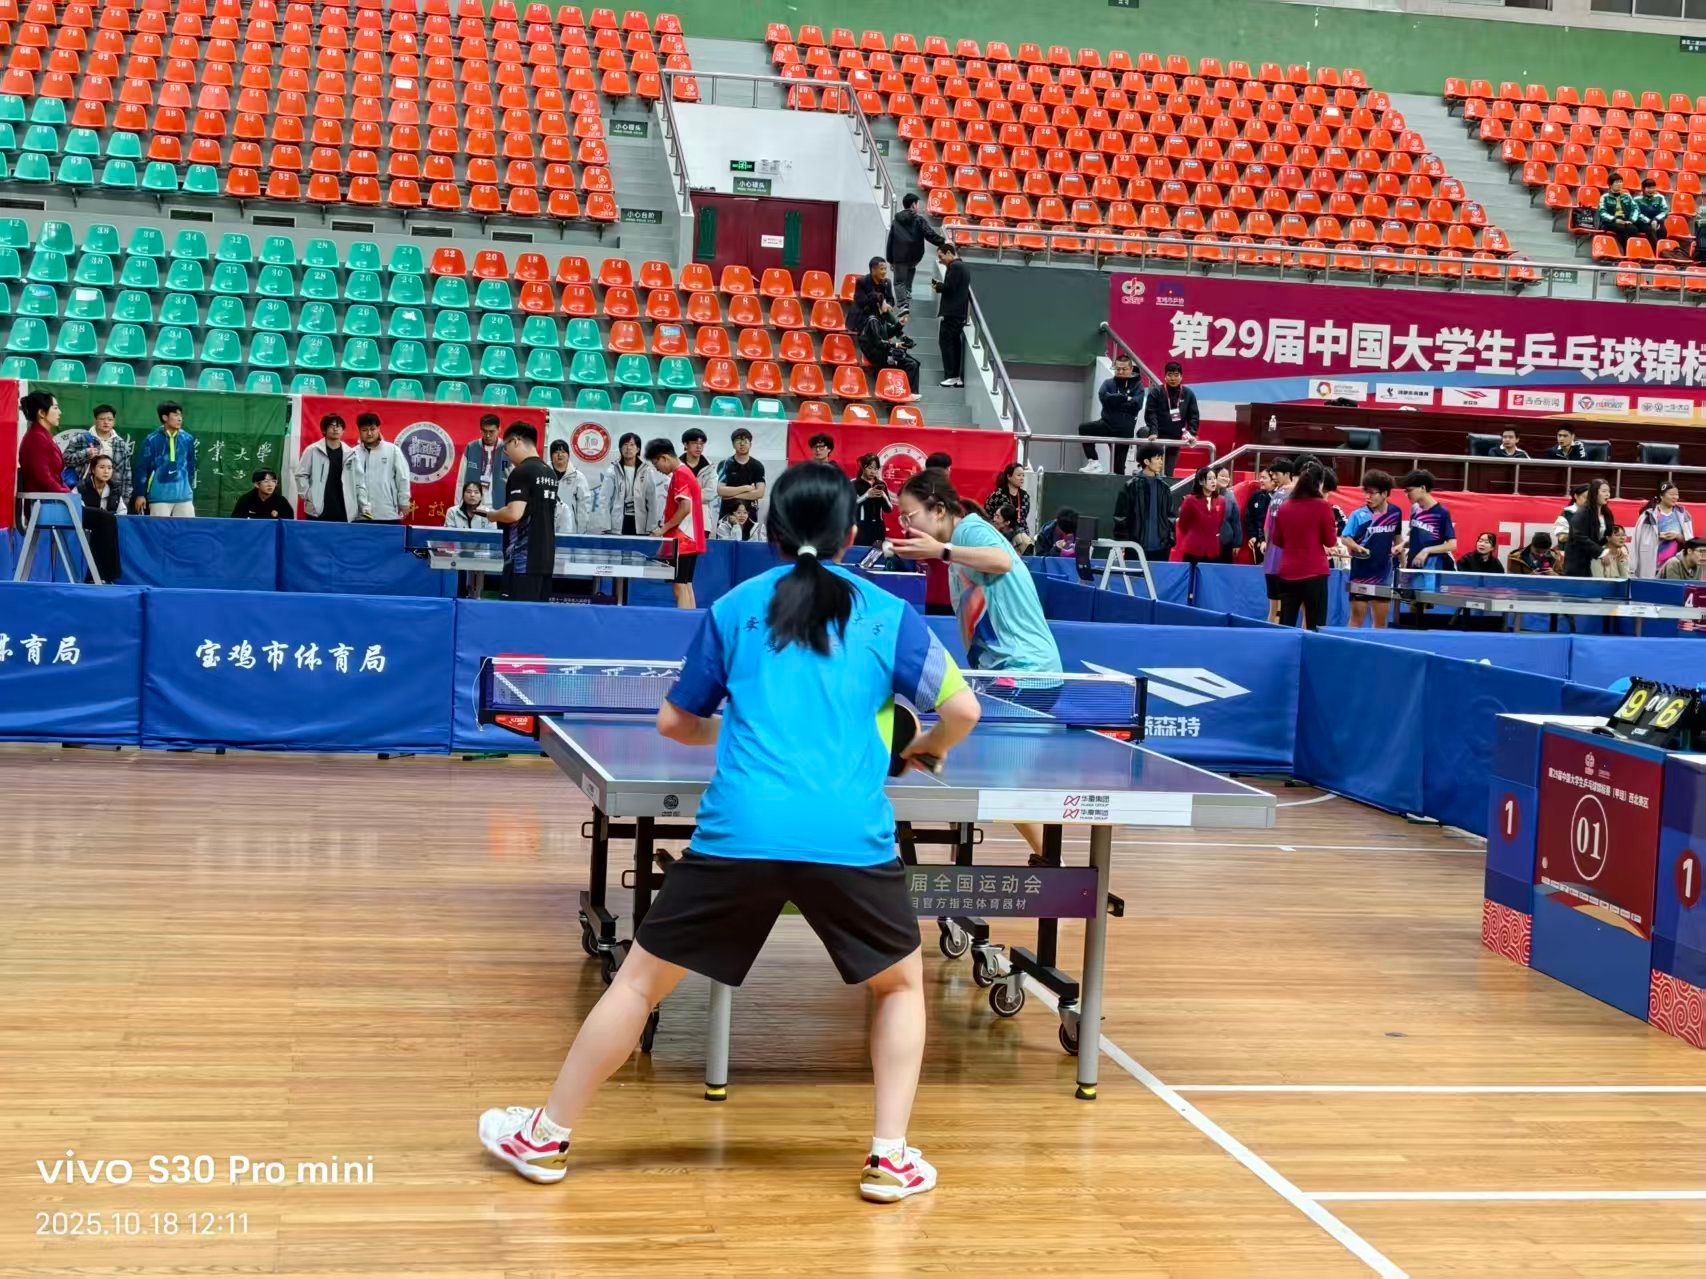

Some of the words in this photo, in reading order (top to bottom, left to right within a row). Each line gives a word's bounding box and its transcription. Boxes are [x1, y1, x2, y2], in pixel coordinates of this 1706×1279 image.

[611, 261, 622, 269] 14
[446, 280, 457, 288] 22
[489, 282, 500, 290] 20
[700, 296, 709, 304] 10
[448, 313, 459, 321] 22
[622, 324, 633, 332] 14
[708, 329, 718, 338] 10
[494, 349, 506, 358] 20
[628, 358, 639, 366] 14
[717, 362, 728, 370] 10
[495, 388, 506, 396] 20
[195, 638, 386, 672] 宝鸡市体育局
[1621, 690, 1648, 718] 9
[1656, 699, 1684, 728] 6
[1504, 800, 1514, 835] 1
[1577, 816, 1602, 861] 01
[1683, 858, 1694, 898] 1
[910, 873, 1042, 894] 届全国运动会
